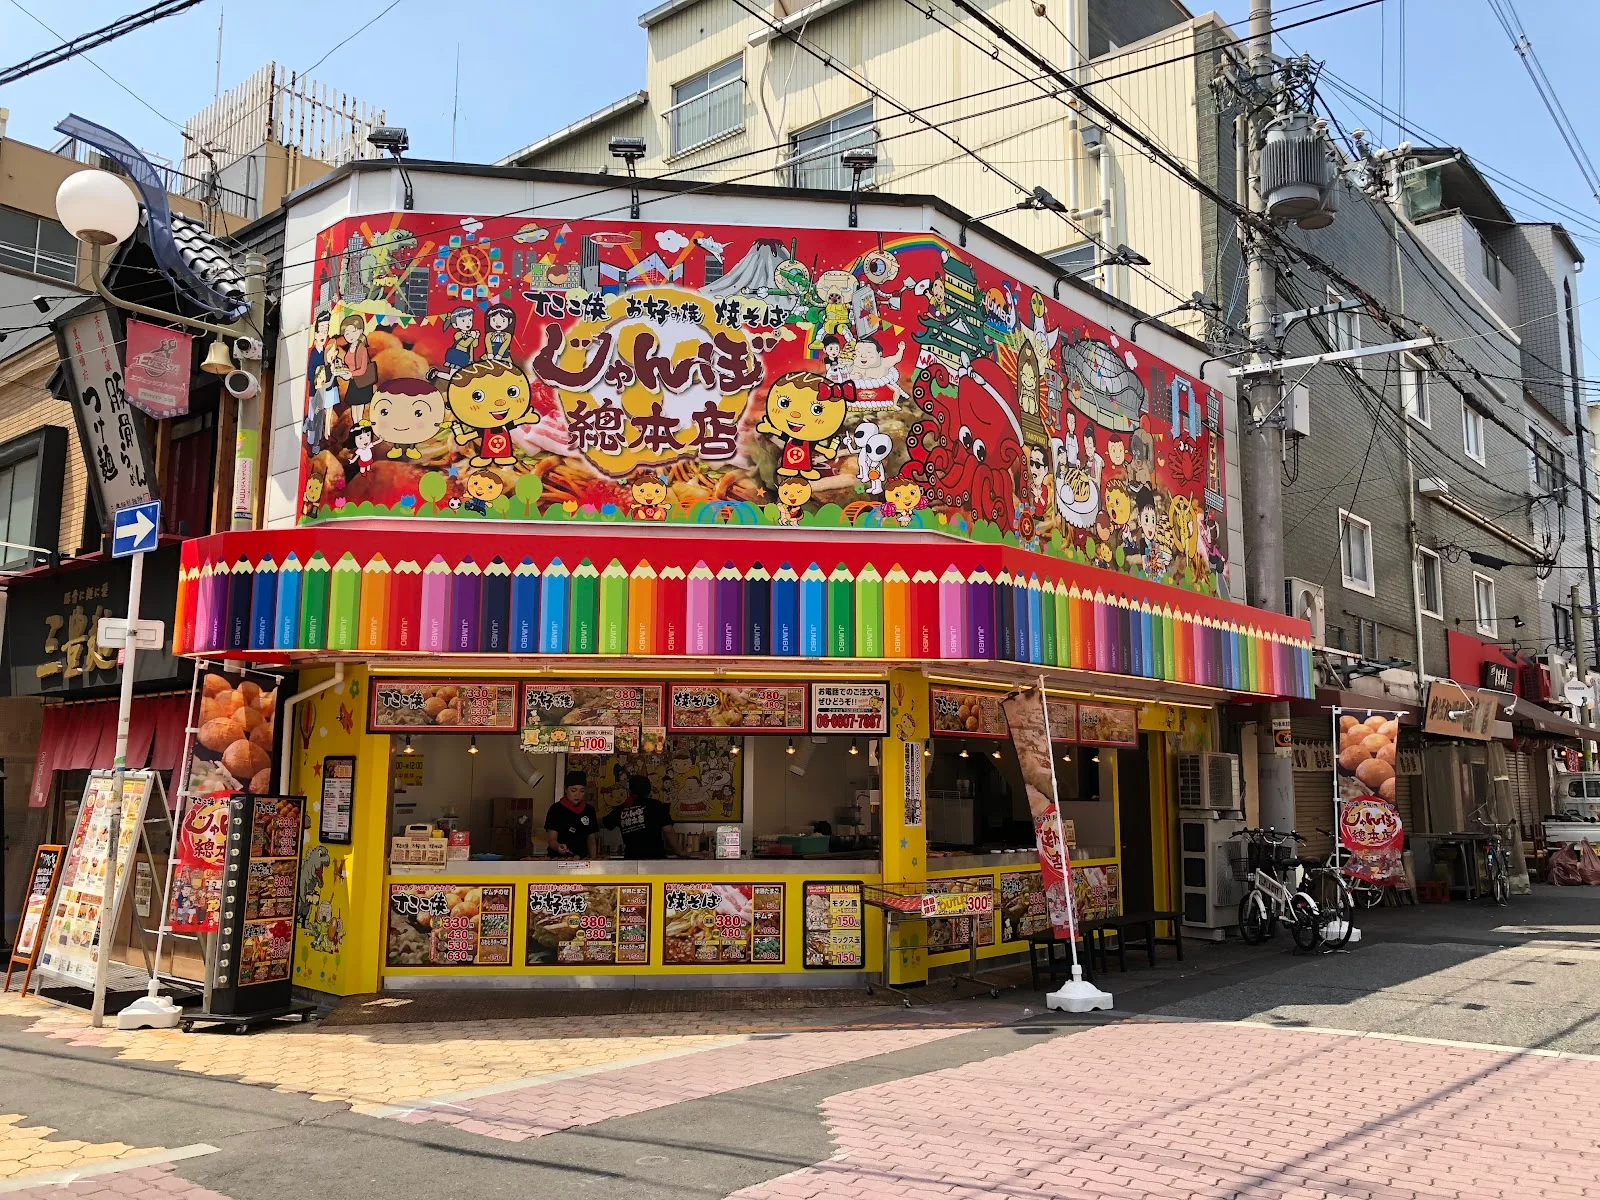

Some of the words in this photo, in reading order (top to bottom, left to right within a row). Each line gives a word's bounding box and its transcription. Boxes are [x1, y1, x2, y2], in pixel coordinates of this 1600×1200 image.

[626, 295, 704, 324] お好み焼
[714, 299, 789, 329] 焼そば
[980, 294, 1015, 327] JUMBO
[532, 323, 778, 395] じゃんぼ
[674, 691, 719, 708] 焼そば
[818, 688, 881, 696] お電話でのご注文も
[1342, 811, 1400, 827] じゃんぼ
[392, 892, 450, 916] たこ焼
[530, 892, 587, 915] お好み焼
[666, 890, 722, 911] 焼そば
